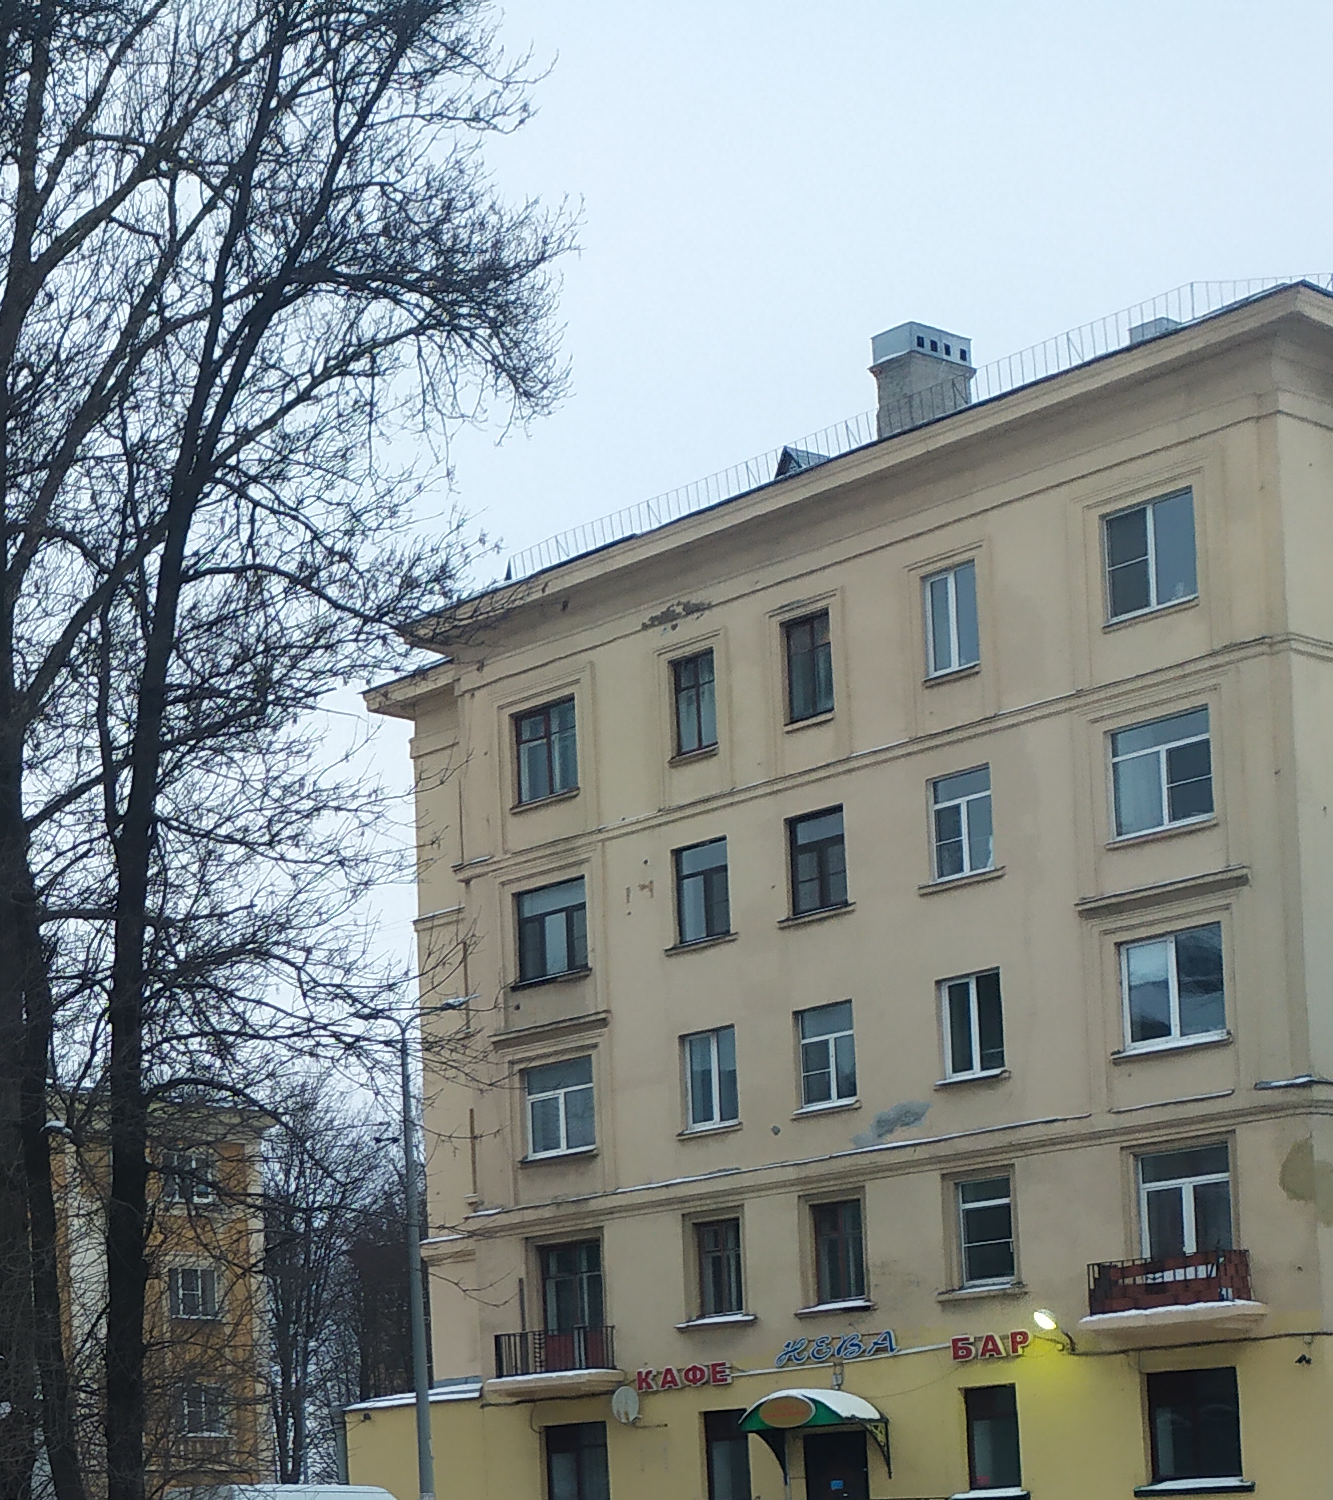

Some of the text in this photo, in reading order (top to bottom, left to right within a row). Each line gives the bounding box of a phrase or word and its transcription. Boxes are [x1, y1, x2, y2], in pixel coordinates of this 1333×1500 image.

[636, 1329, 1030, 1391] КАФЕ НЕВА БАР
